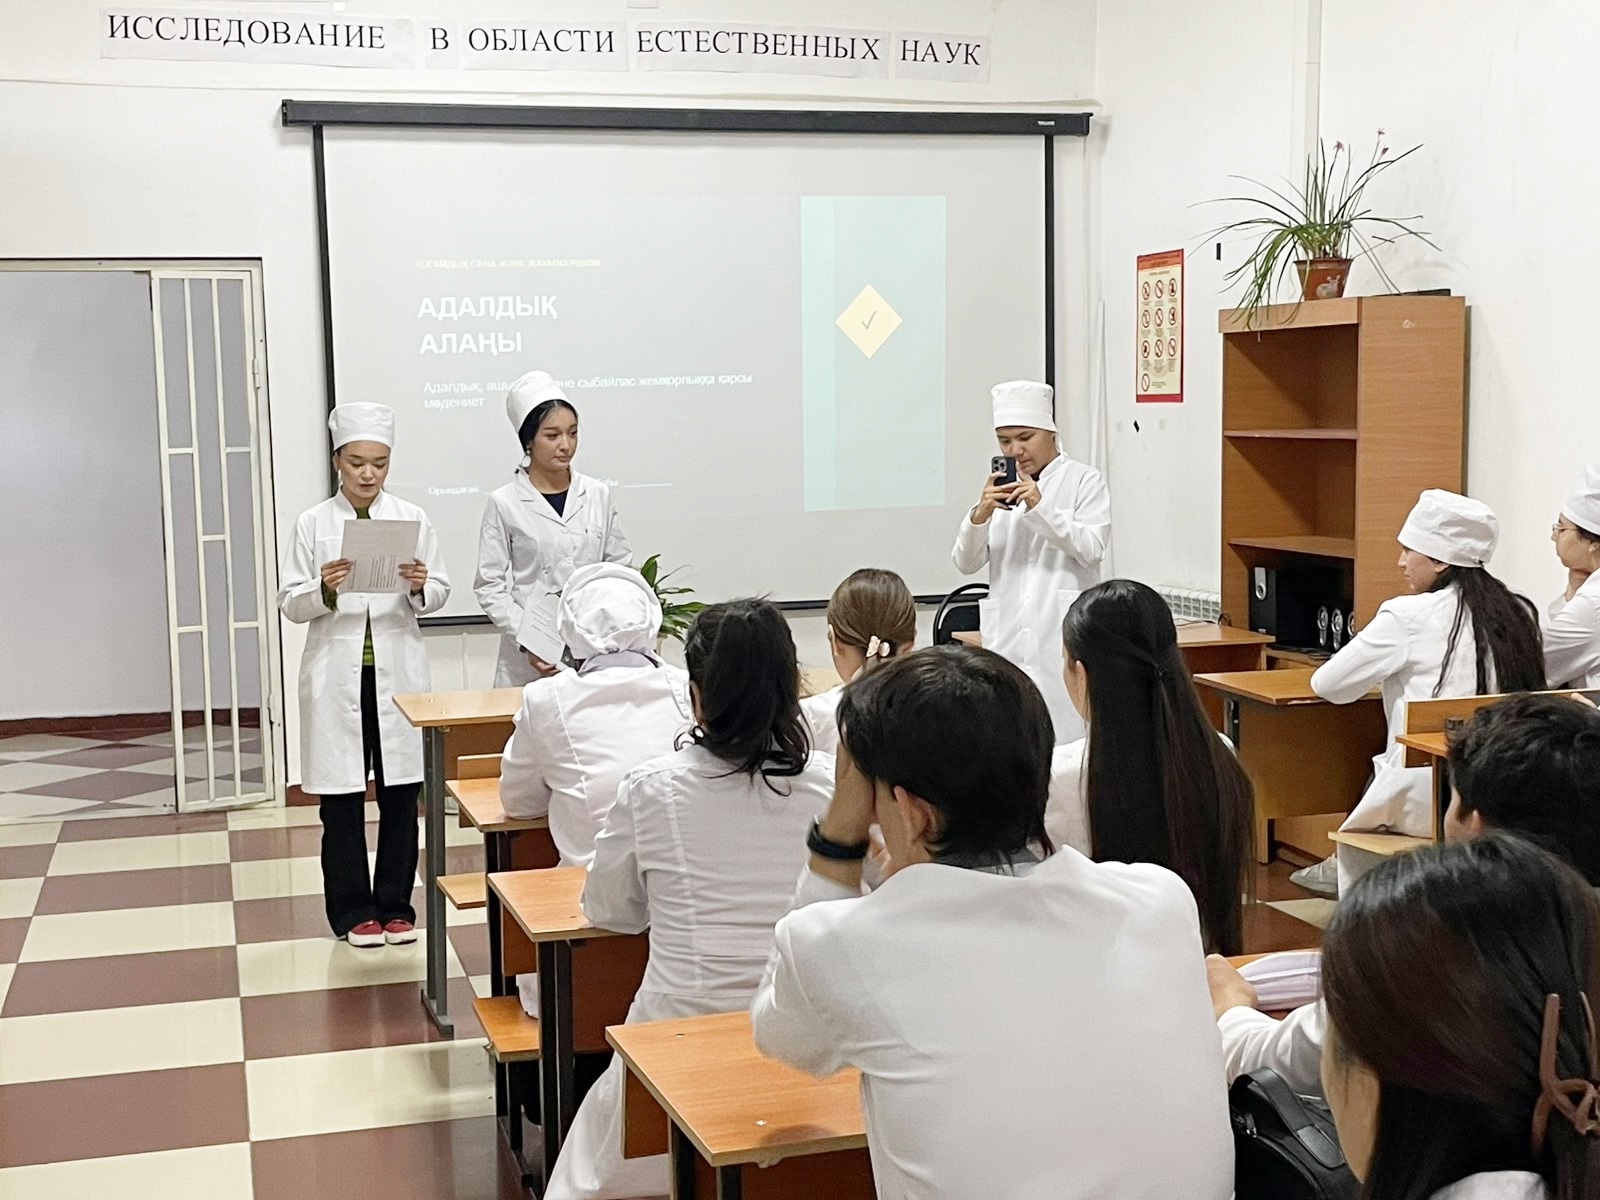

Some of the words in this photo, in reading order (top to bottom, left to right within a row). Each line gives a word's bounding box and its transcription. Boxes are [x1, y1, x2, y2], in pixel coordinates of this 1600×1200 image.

[107, 14, 386, 50] ИССЛЕДОВАНИЕ
[430, 27, 450, 51] В
[467, 27, 615, 53] ОБЛАСТИ
[636, 29, 881, 61] ЕСТЕСТВЕННЫХ
[900, 38, 981, 66] НАУК
[417, 295, 558, 321] АДАЛДЫҚ
[419, 331, 522, 356] АЛАҢЫ
[577, 376, 637, 389] сыбайлас
[717, 373, 753, 387] қарсы
[423, 397, 486, 411] мәдениет
